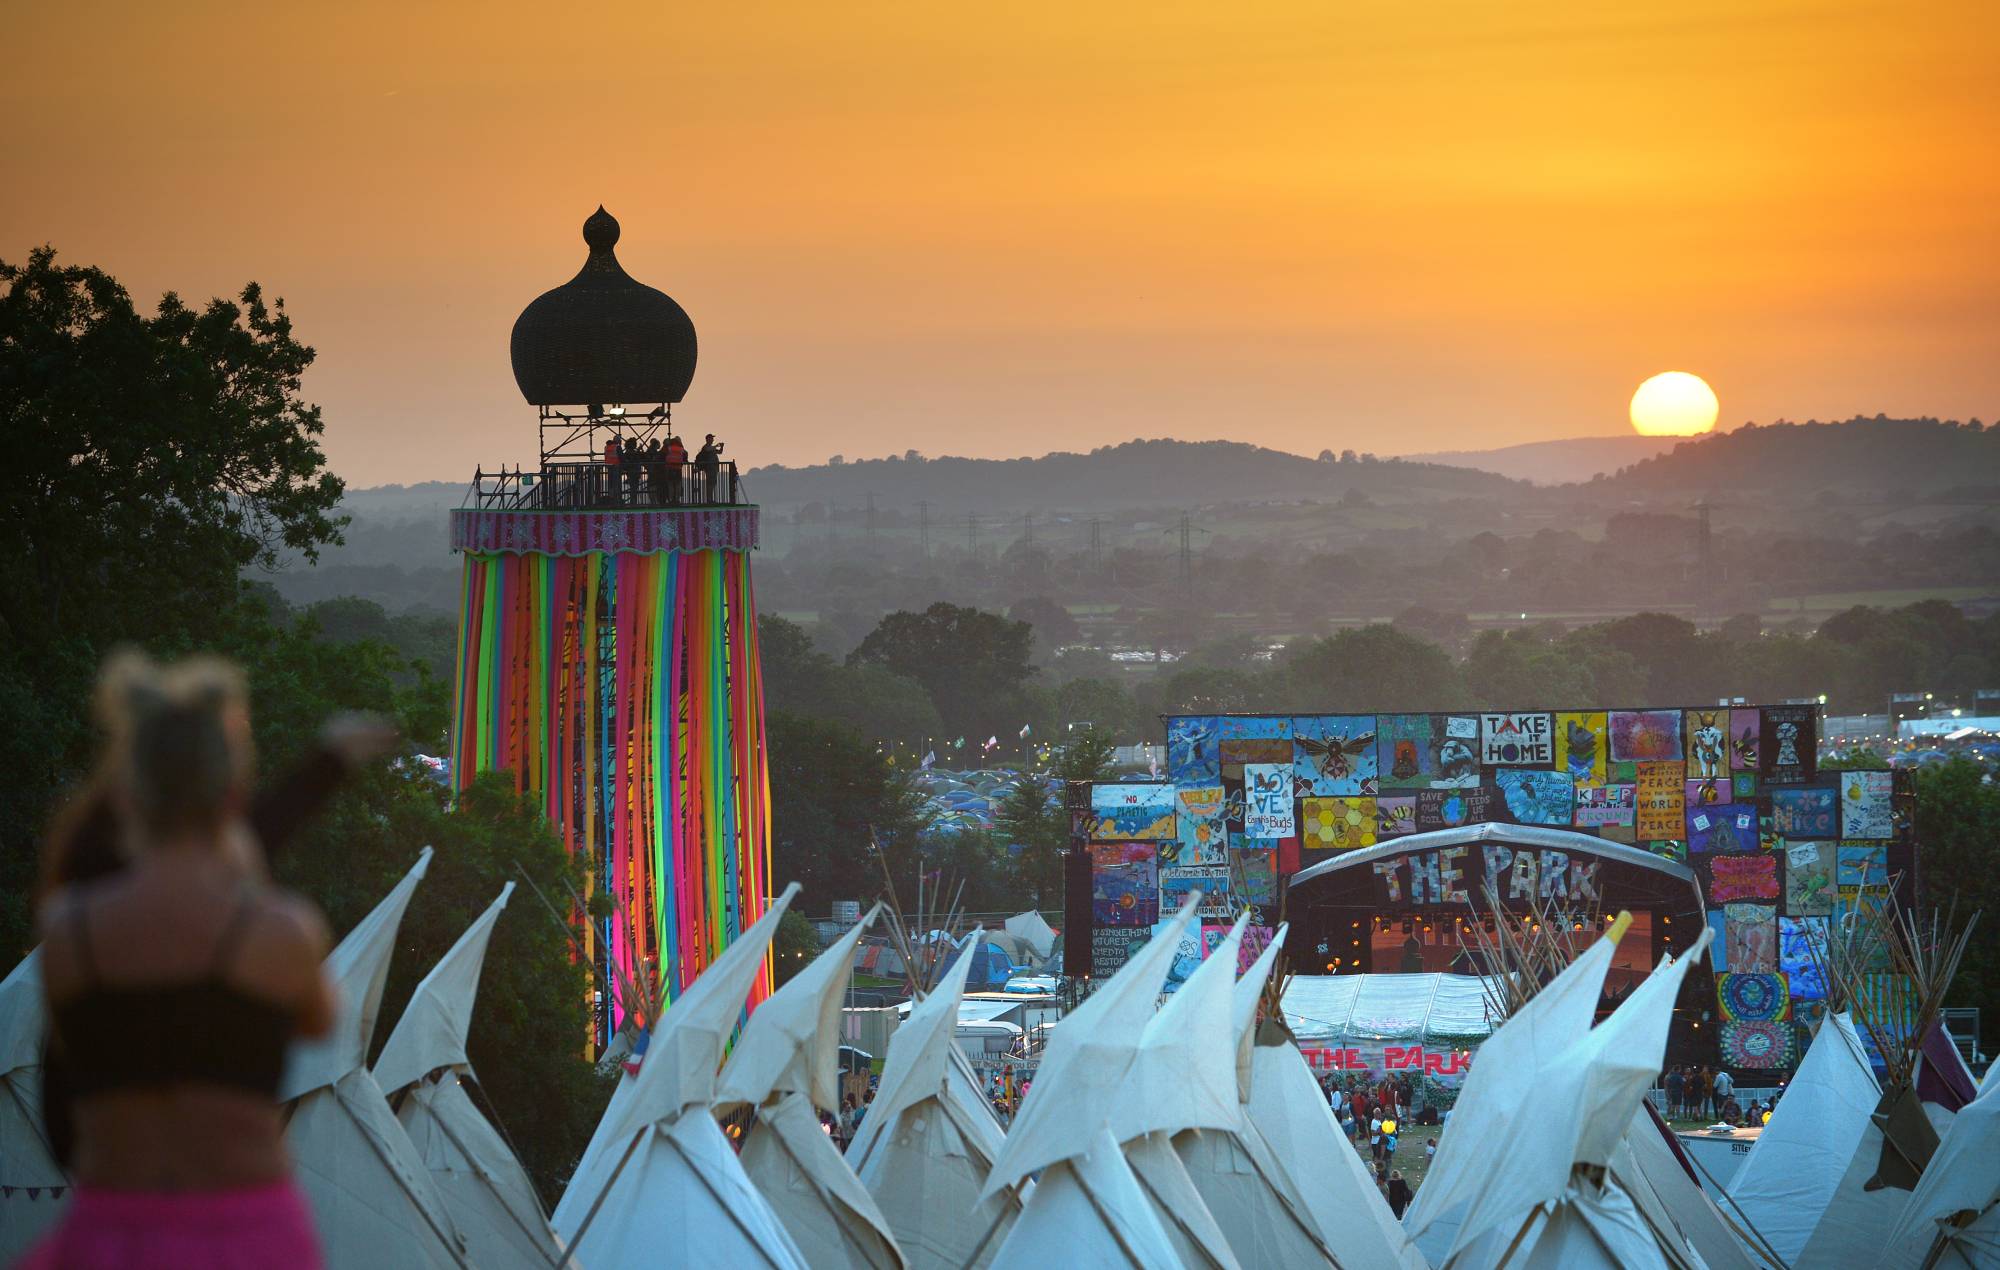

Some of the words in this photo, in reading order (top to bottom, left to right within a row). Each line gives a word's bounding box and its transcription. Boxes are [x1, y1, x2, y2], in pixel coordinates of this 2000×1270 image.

[1487, 716, 1546, 734] TAKE
[1529, 734, 1540, 742] IT
[1488, 743, 1548, 762] HOME
[1420, 792, 1443, 801] SAVE
[1579, 787, 1630, 800] KEEP
[1125, 795, 1137, 804] NO
[1640, 800, 1681, 809] WORLD
[1640, 820, 1680, 830] PEACE
[1373, 847, 1469, 903] THE
[1482, 846, 1601, 902] PARK
[1301, 1048, 1369, 1070] THE
[1384, 1046, 1472, 1076] PARK
